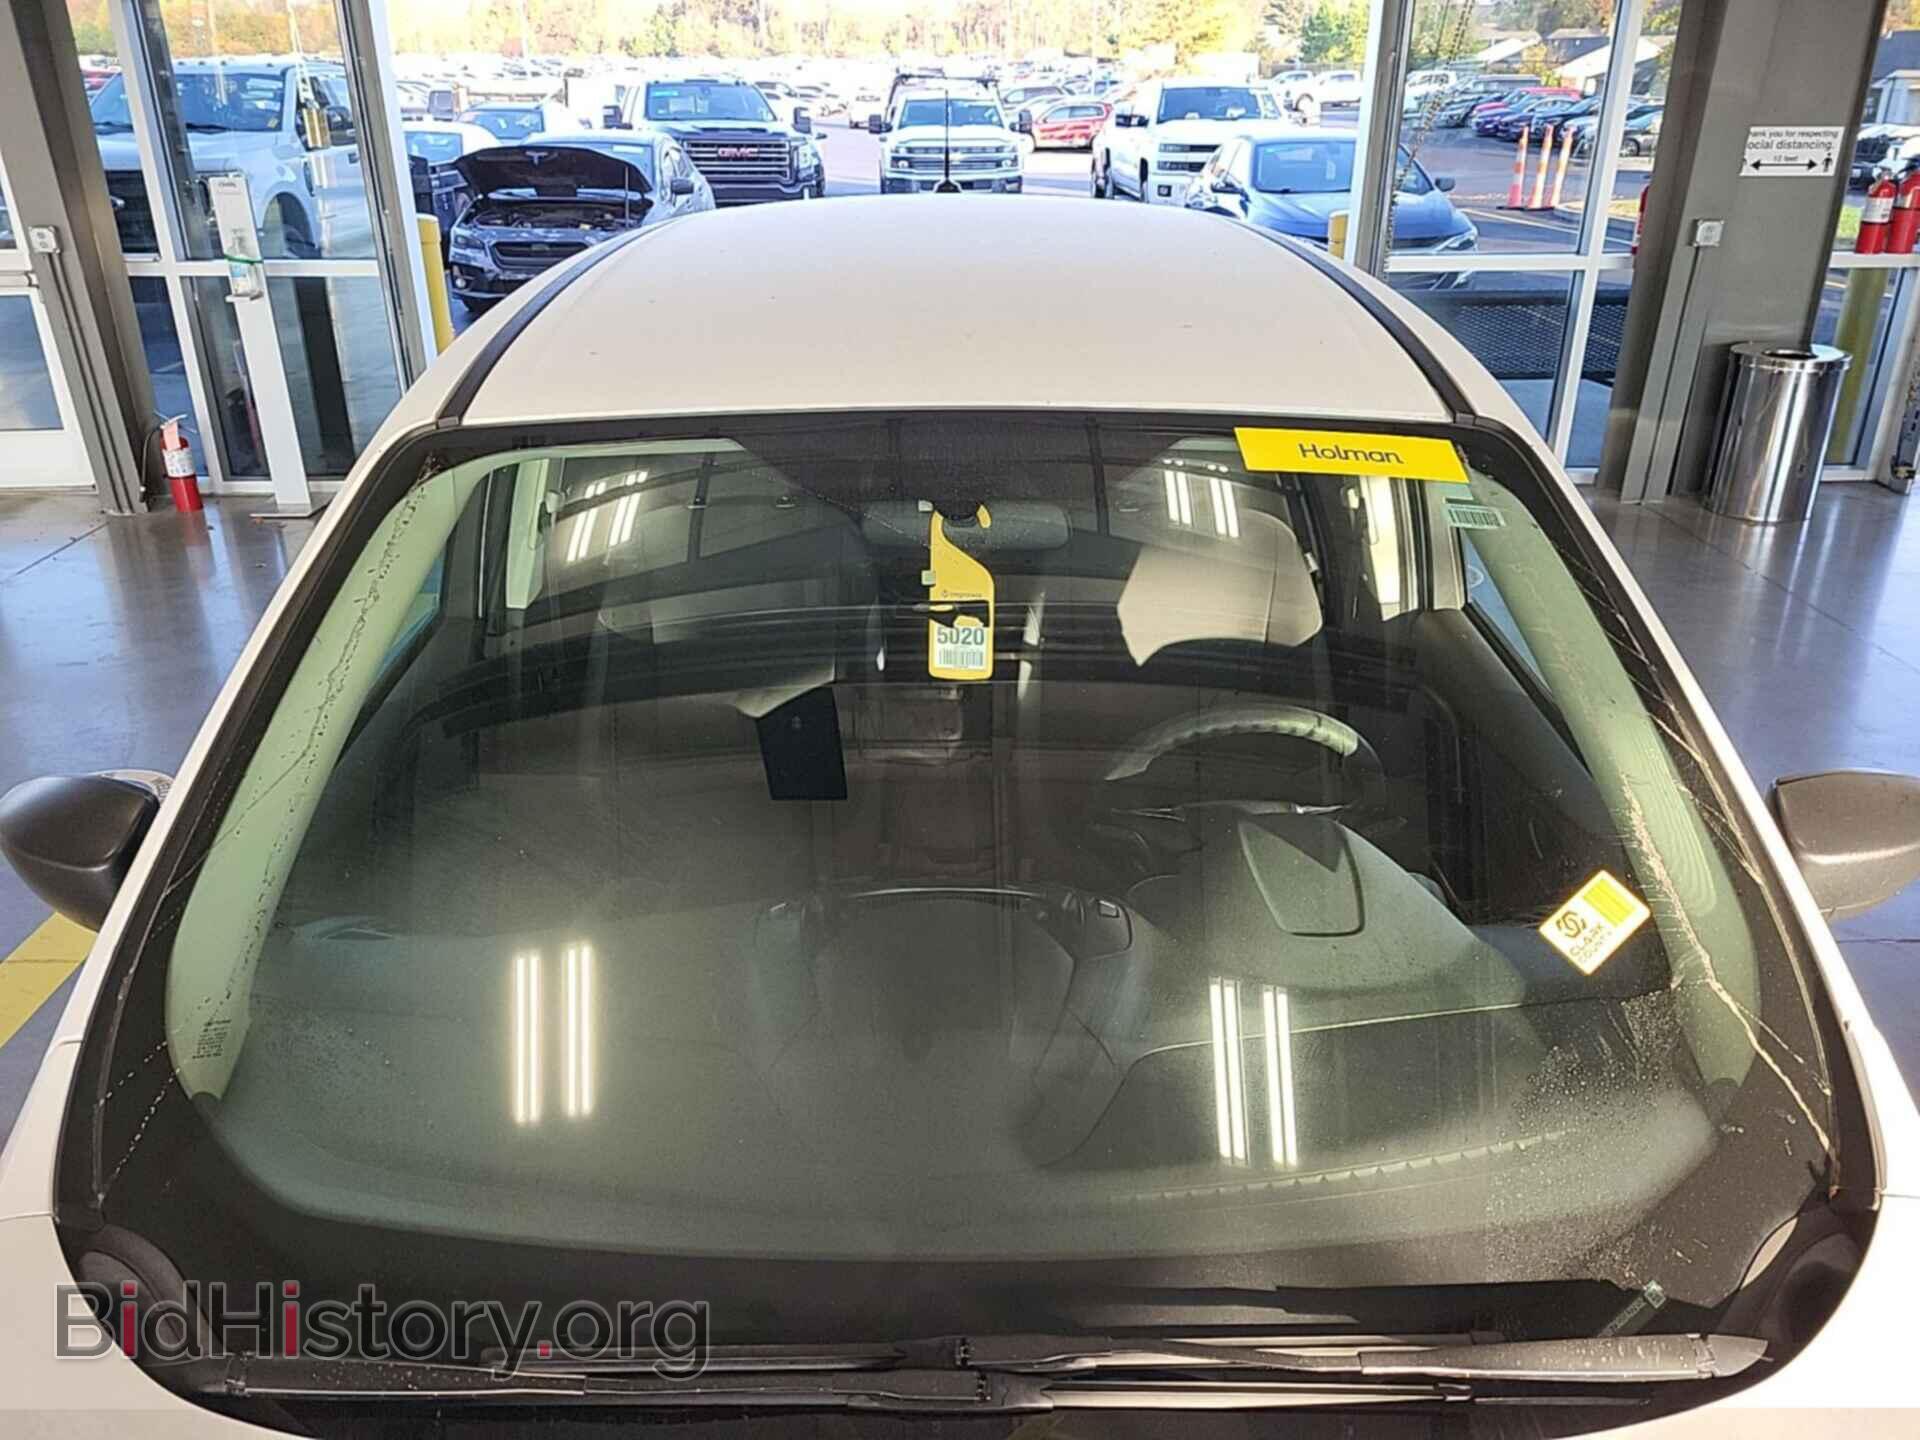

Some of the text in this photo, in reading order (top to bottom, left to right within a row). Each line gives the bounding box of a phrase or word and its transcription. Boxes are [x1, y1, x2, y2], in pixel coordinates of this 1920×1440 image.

[1769, 132, 1783, 140] you
[1798, 131, 1839, 139] respecting
[1747, 140, 1834, 151] ocial distancing.
[718, 147, 758, 157] GMC
[1298, 443, 1404, 464] Holman
[937, 626, 985, 646] 5020
